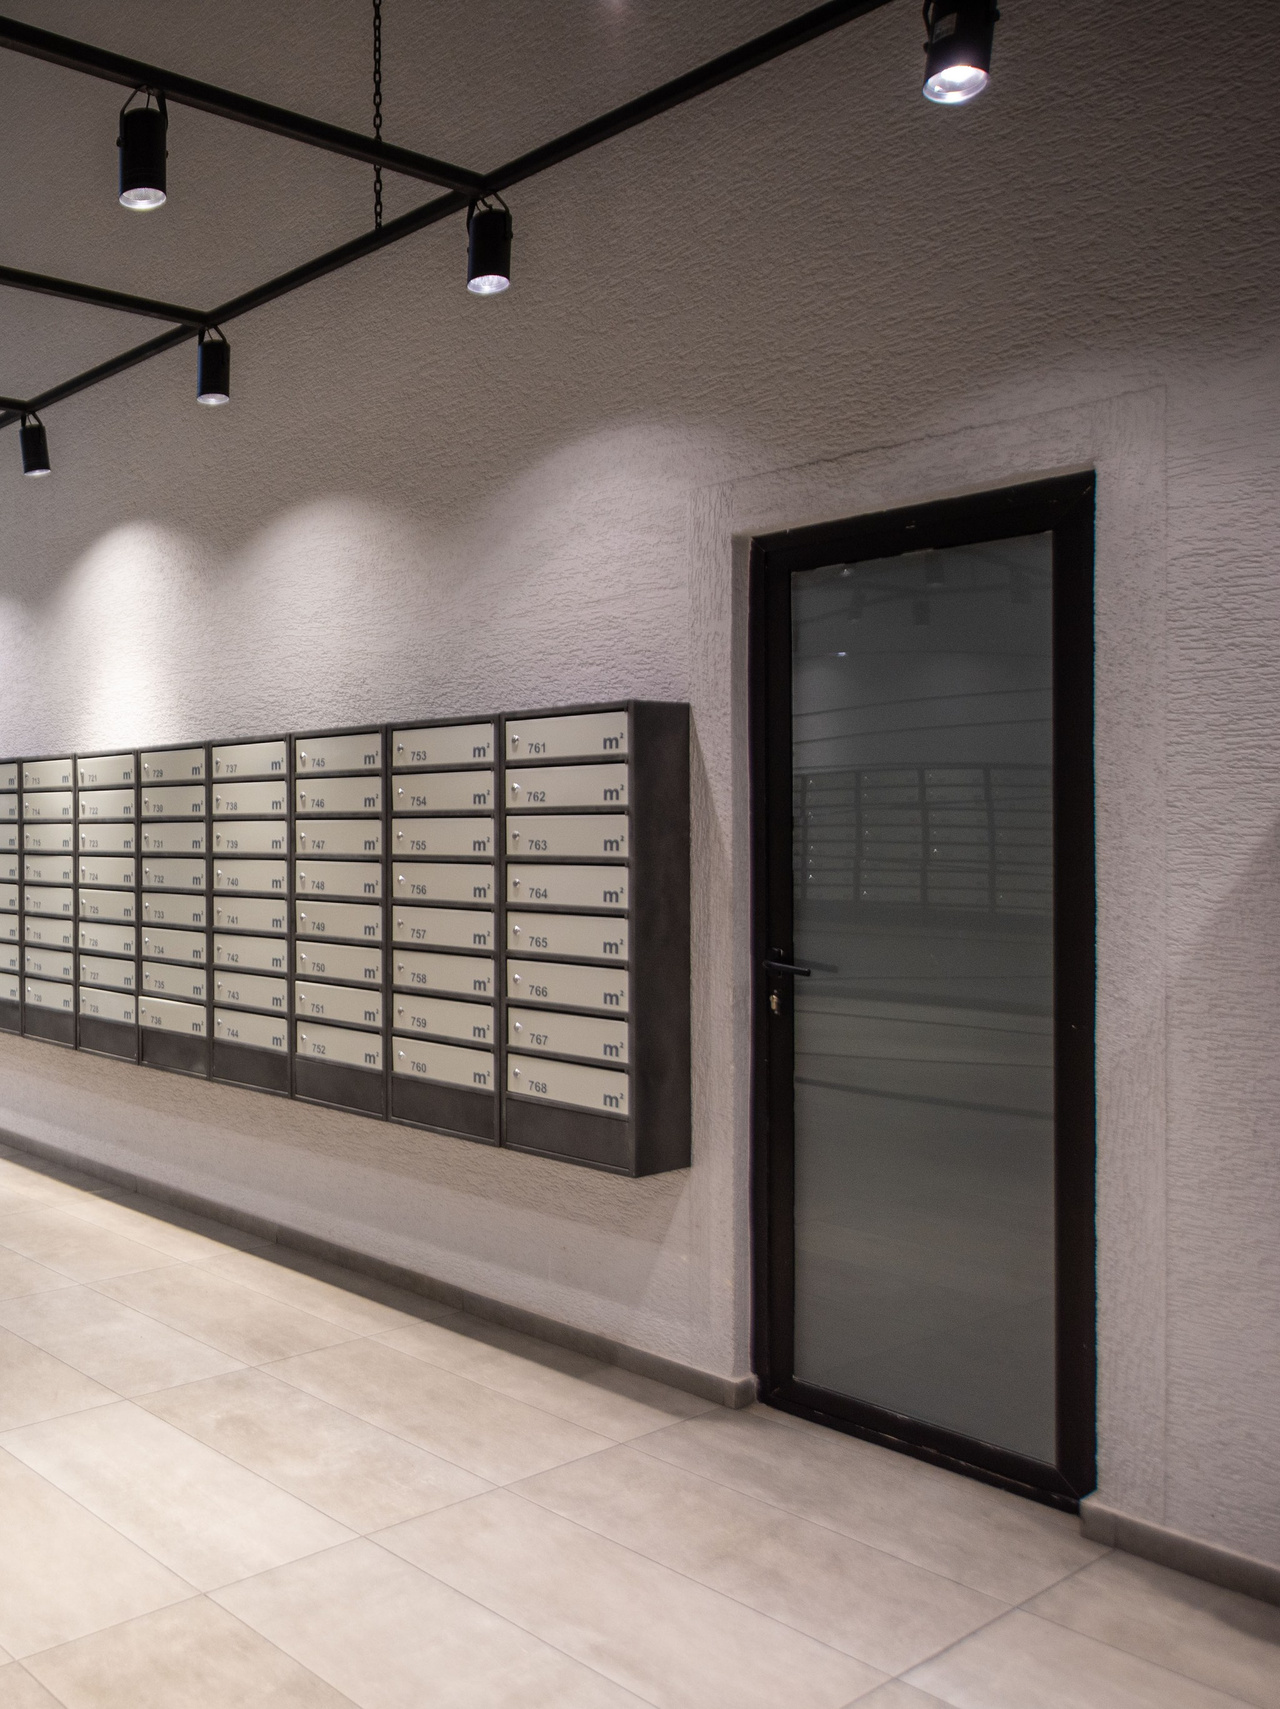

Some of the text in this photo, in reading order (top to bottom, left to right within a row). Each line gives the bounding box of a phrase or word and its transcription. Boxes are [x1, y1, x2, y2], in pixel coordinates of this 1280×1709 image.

[528, 742, 546, 754] 761
[411, 750, 427, 762] 753
[311, 757, 326, 768] 745
[153, 769, 164, 778] 729
[225, 764, 238, 774] 737
[88, 774, 98, 783] 721
[410, 796, 427, 807] 754
[527, 791, 546, 803] 762
[226, 801, 238, 811] 738
[311, 798, 325, 808] 746
[89, 806, 99, 815] 722
[153, 804, 164, 813] 730
[89, 839, 99, 848] 723
[153, 839, 163, 849] 731
[226, 839, 239, 849] 739
[311, 840, 325, 850] 747
[410, 840, 427, 851] 755
[528, 839, 548, 851] 763
[89, 873, 99, 881] 724
[154, 874, 165, 884] 732
[227, 877, 239, 887] 740
[311, 880, 325, 891] 748
[410, 884, 427, 895] 756
[529, 887, 548, 899] 764
[89, 905, 99, 915] 725
[154, 910, 165, 920] 733
[227, 915, 238, 925] 741
[311, 921, 325, 932] 749
[410, 928, 427, 939] 757
[89, 938, 98, 947] 726
[529, 936, 548, 949] 765
[154, 945, 165, 955] 734
[227, 953, 239, 963] 742
[312, 962, 326, 973] 750
[90, 971, 99, 980] 727
[411, 972, 427, 984] 758
[154, 979, 165, 989] 735
[227, 990, 240, 1001] 743
[529, 984, 548, 998] 766
[89, 1004, 99, 1014] 728
[311, 1003, 324, 1014] 751
[150, 1015, 162, 1025] 736
[411, 1016, 427, 1029] 759
[227, 1028, 239, 1038] 744
[529, 1033, 548, 1046] 767
[312, 1043, 326, 1055] 752
[411, 1061, 427, 1073] 760
[528, 1080, 548, 1094] 768
